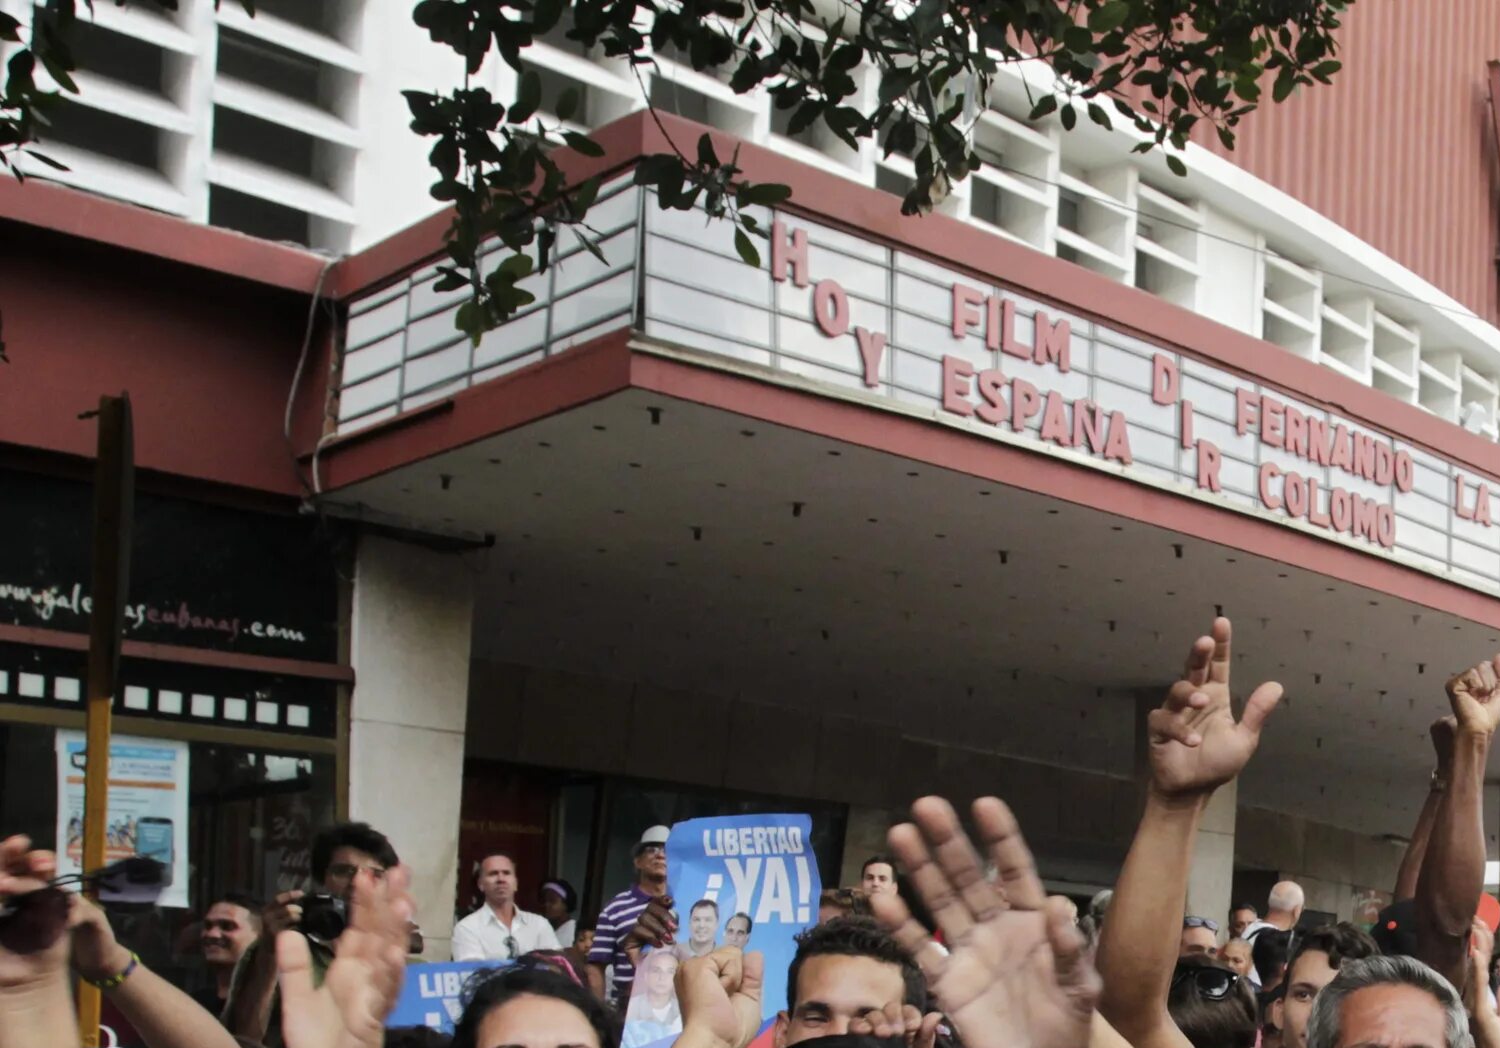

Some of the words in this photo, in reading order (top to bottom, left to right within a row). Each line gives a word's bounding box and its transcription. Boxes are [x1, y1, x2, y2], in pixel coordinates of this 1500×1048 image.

[772, 220, 887, 388] HOY
[952, 282, 1071, 373] FILM
[1152, 352, 1222, 492] DIR
[1235, 386, 1414, 493] FERNANDO
[1259, 461, 1396, 548] COLOMO
[1454, 474, 1492, 528] LA
[703, 827, 804, 856] LIBERTAD
